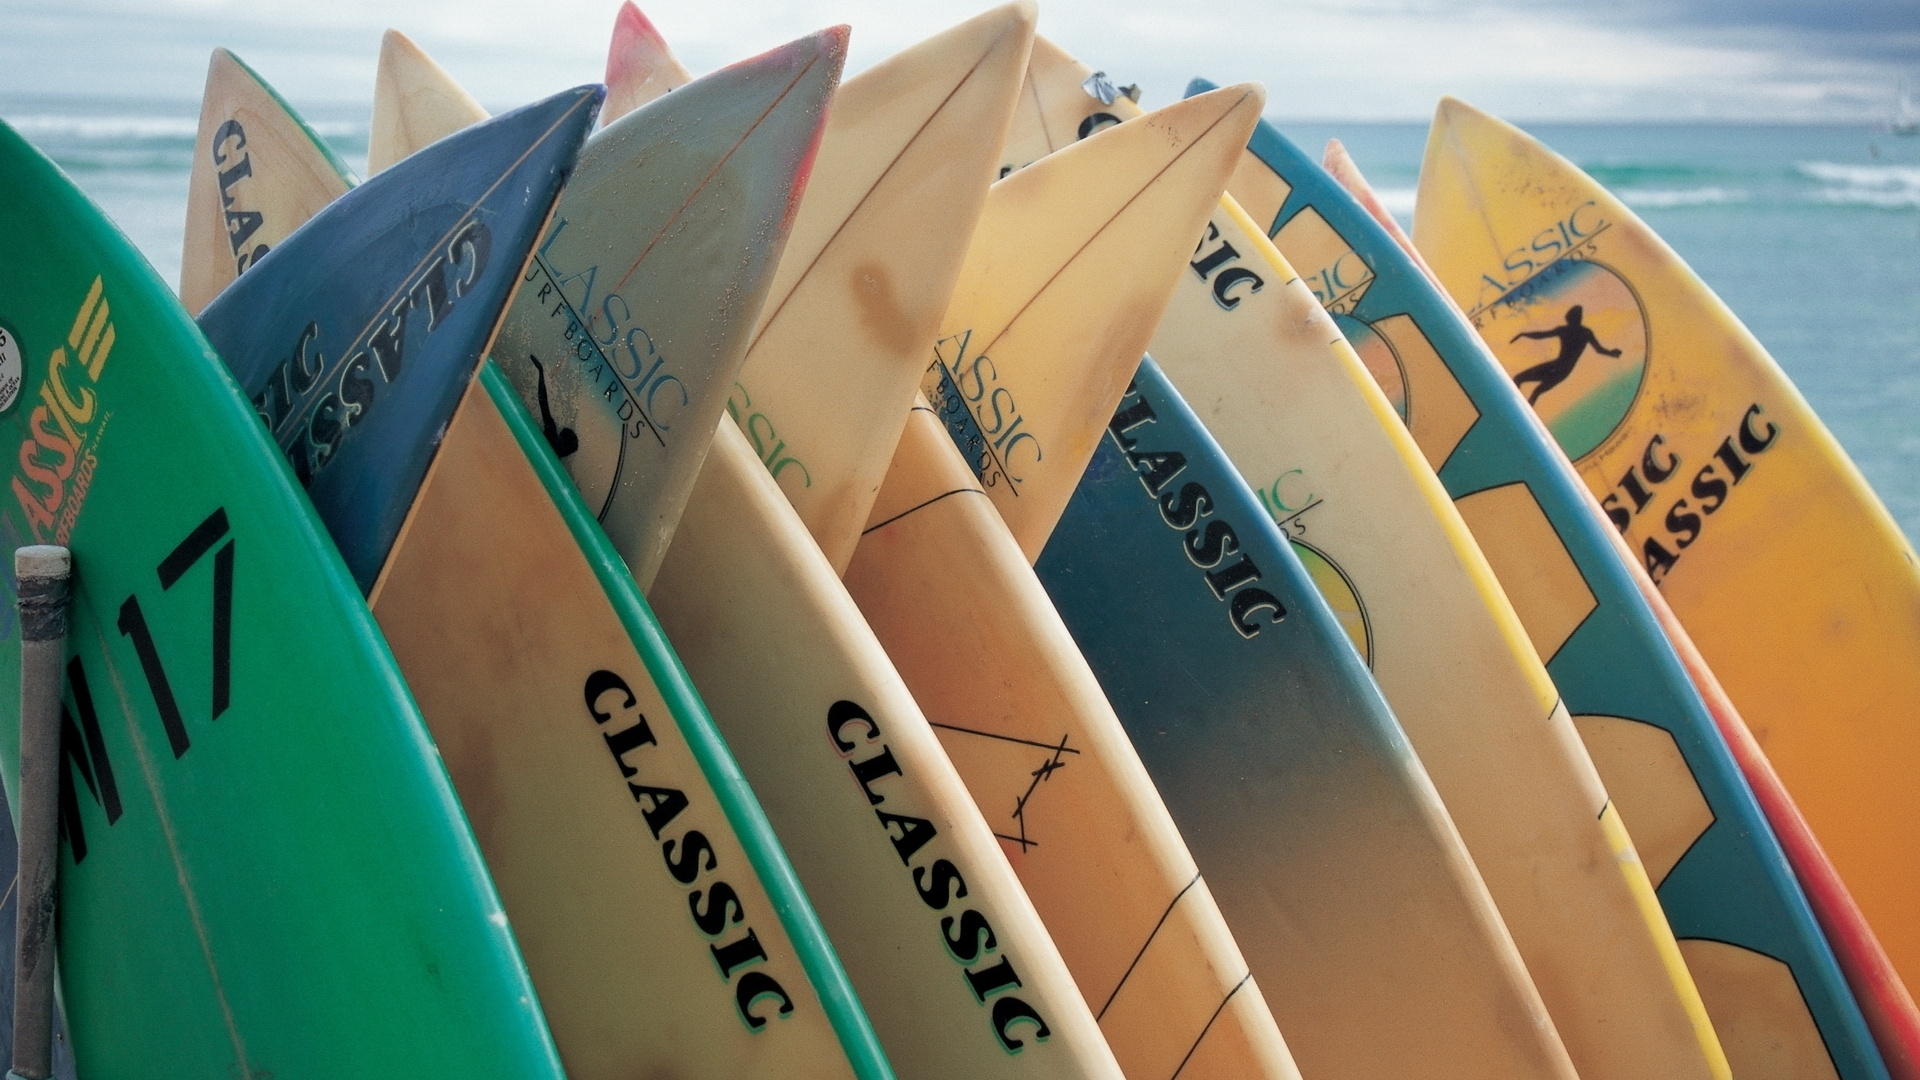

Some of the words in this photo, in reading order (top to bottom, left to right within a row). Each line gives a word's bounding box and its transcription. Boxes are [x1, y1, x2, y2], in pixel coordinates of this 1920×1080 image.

[537, 210, 689, 431] LASSIC
[1470, 201, 1603, 313] ASSIC
[937, 329, 1042, 483] ASSIC
[1107, 380, 1287, 639] LASSIC
[1644, 403, 1781, 587] ASSIC
[583, 669, 794, 1035] CLASSIC
[827, 700, 1051, 1055] CLASSIC
